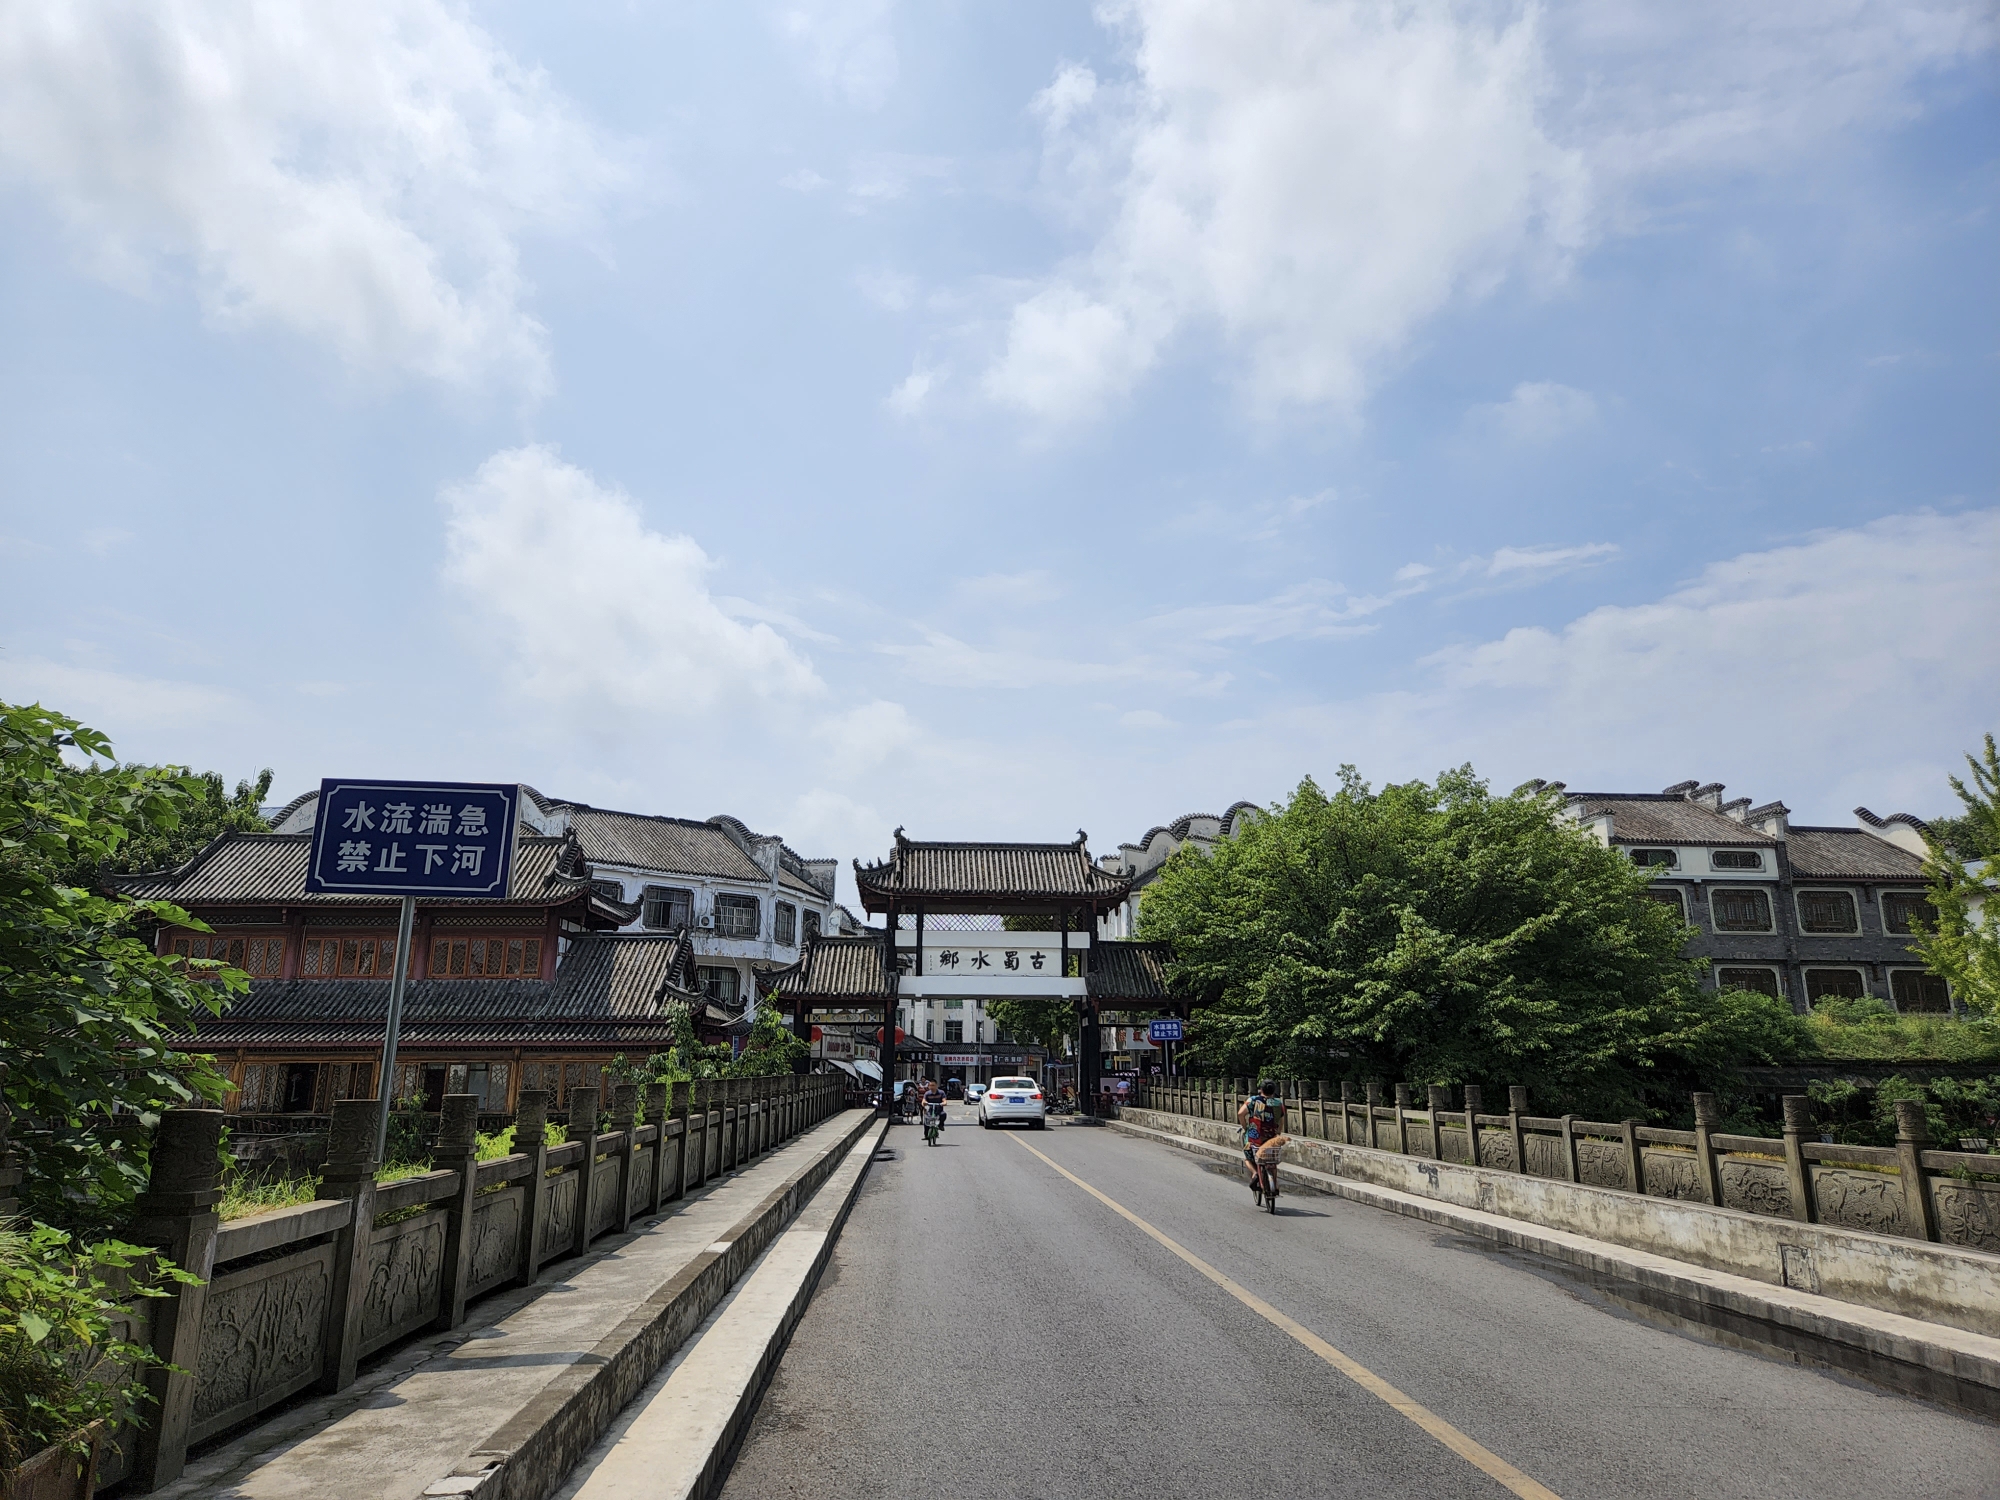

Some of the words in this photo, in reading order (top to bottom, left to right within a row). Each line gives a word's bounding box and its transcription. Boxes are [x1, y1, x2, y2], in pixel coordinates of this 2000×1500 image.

[341, 800, 489, 836] 水流湍急
[336, 839, 486, 876] 禁止下河
